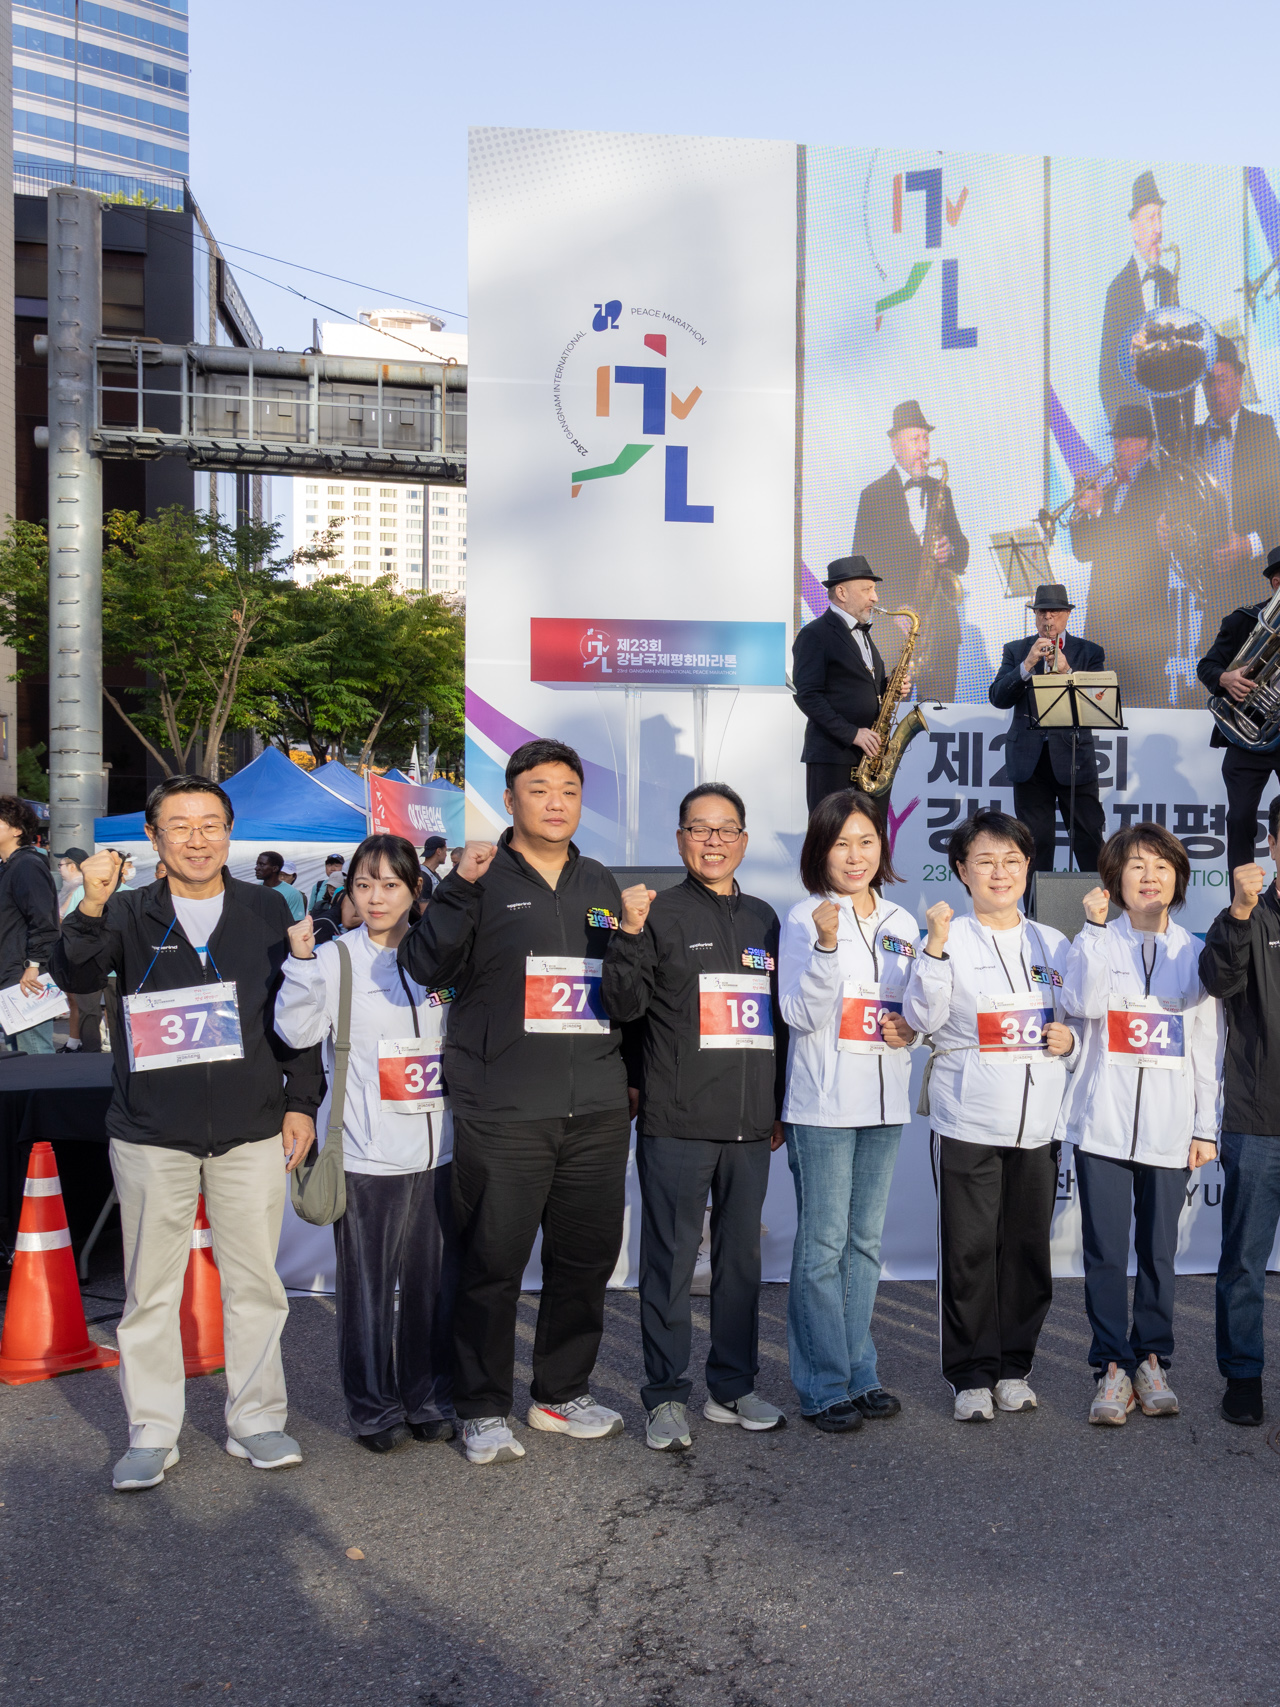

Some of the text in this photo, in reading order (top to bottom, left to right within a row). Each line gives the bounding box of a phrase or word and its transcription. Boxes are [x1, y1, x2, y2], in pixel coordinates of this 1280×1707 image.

[553, 307, 708, 457] 23rd GANGNAM INTERNATIONAL PEACE MARATHON
[616, 638, 662, 652] 제23회
[616, 652, 738, 668] 강남국제평화마라톤
[927, 731, 1128, 791] 제2회
[551, 982, 592, 1013] 27
[160, 1011, 208, 1046] 37
[726, 999, 760, 1029] 18
[1000, 1016, 1042, 1045] 36
[1127, 1018, 1171, 1049] 34
[404, 1061, 444, 1093] 32
